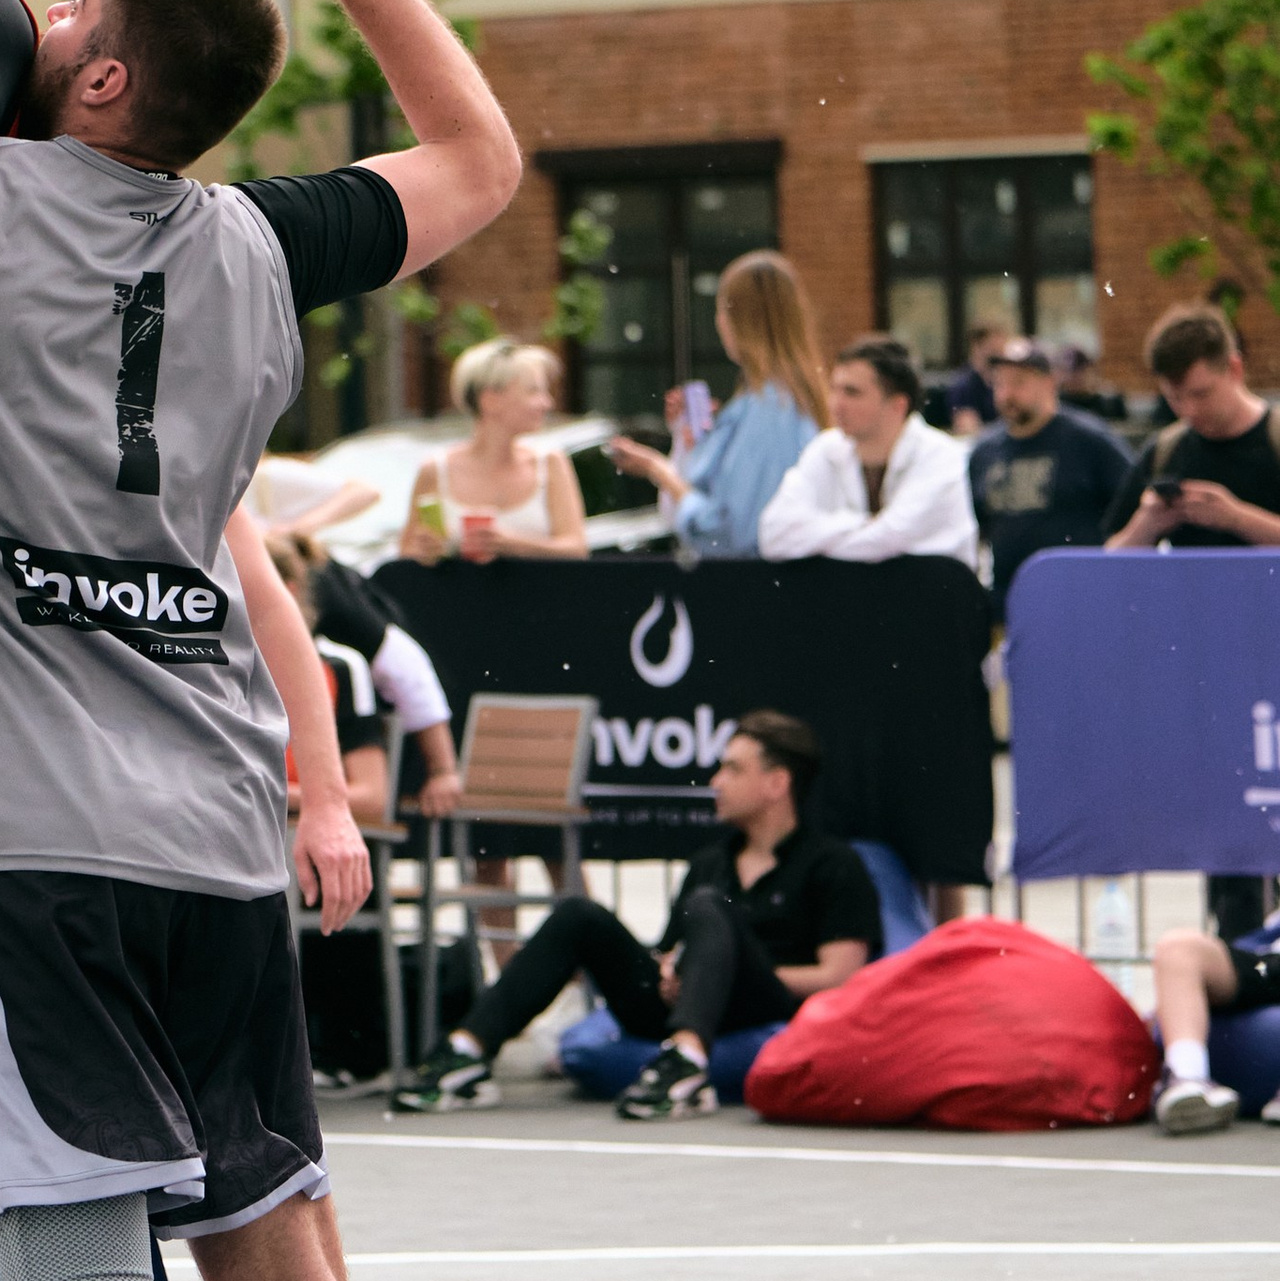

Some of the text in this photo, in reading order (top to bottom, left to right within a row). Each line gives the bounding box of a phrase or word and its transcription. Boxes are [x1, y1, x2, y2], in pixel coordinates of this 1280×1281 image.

[113, 271, 166, 496] 1
[14, 548, 218, 623] invoke
[149, 643, 216, 656] REALITY
[591, 703, 739, 769] nvok
